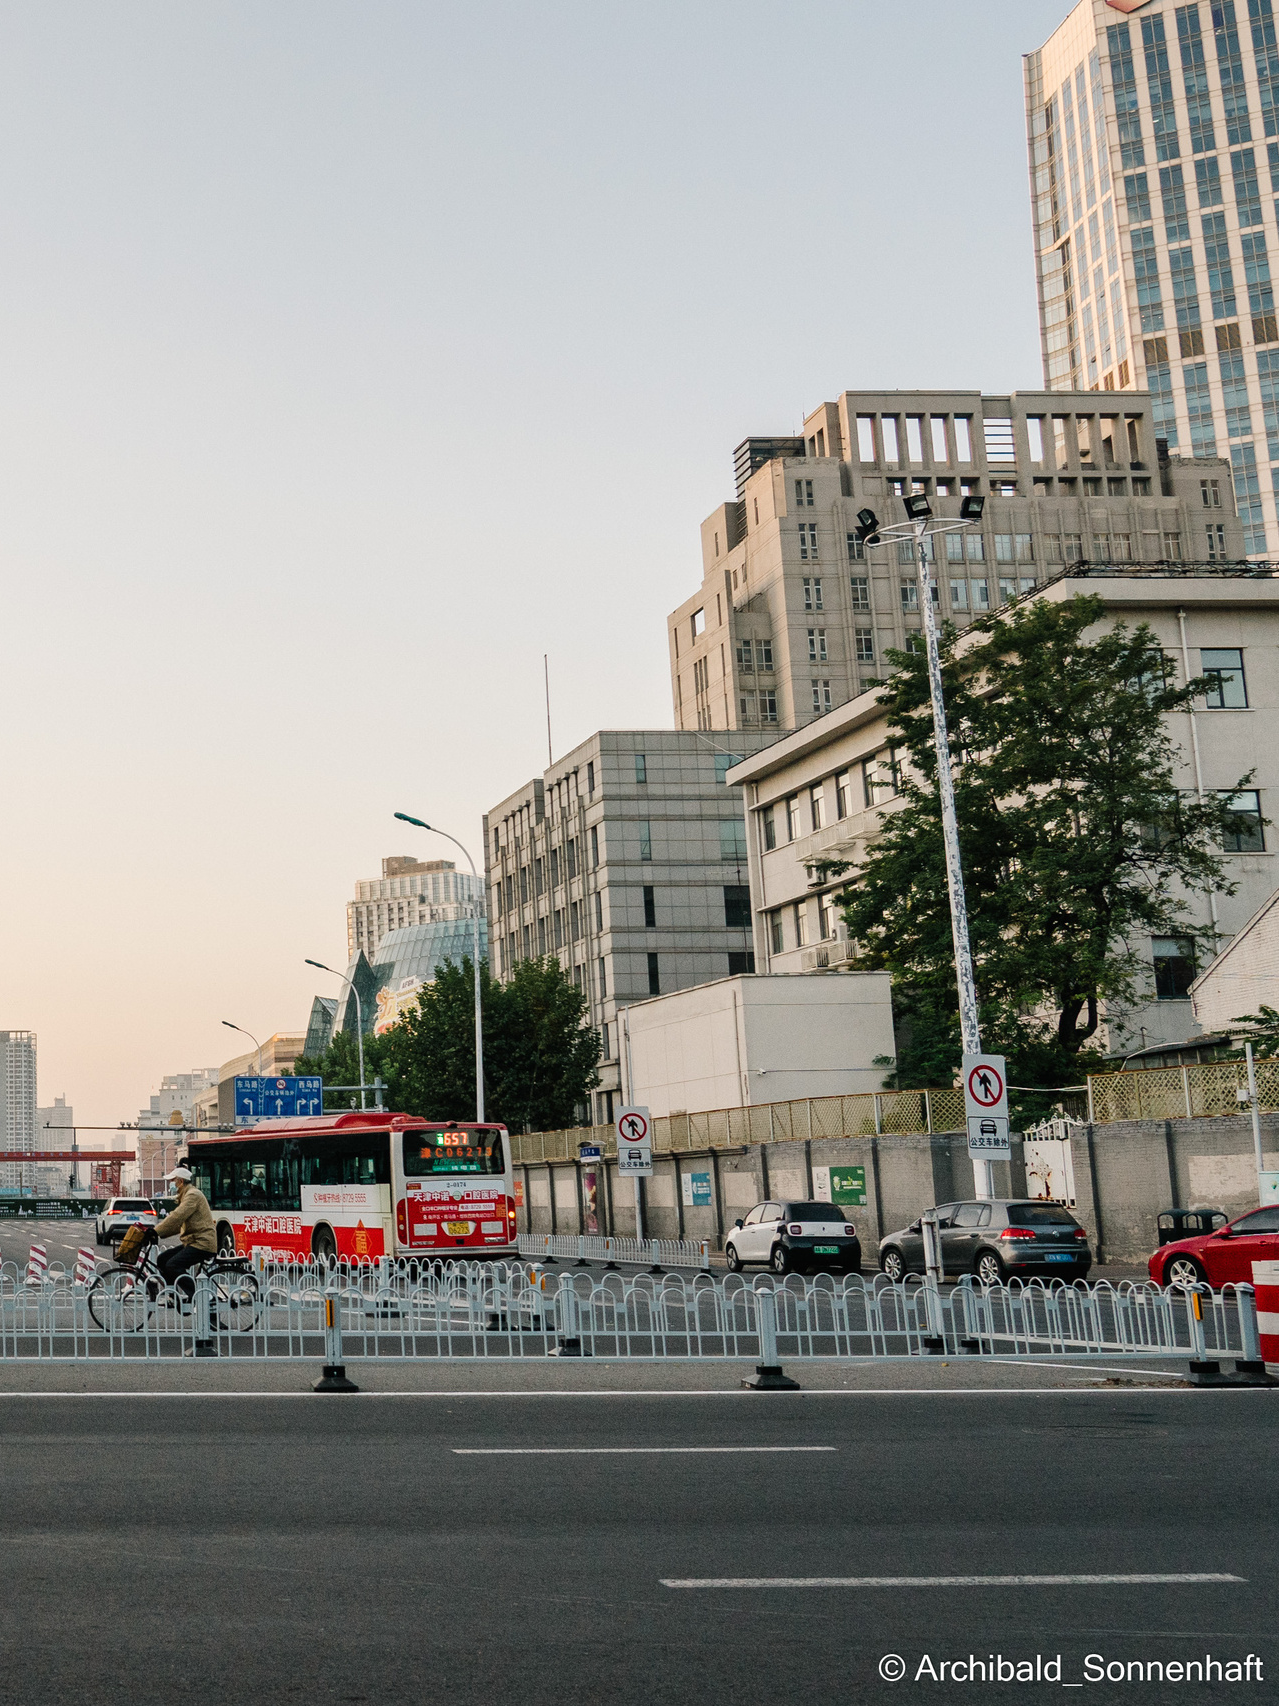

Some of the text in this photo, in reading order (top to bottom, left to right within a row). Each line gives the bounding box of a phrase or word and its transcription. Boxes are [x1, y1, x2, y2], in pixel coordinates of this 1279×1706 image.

[237, 1080, 258, 1089] 东马路
[298, 1080, 320, 1089] 西马路
[444, 1132, 467, 1145] 657
[971, 1137, 1009, 1147] 公交车除外
[414, 1189, 499, 1202] 天津中诺 口腔医院
[244, 1216, 302, 1234] 天津中诺口腔医院
